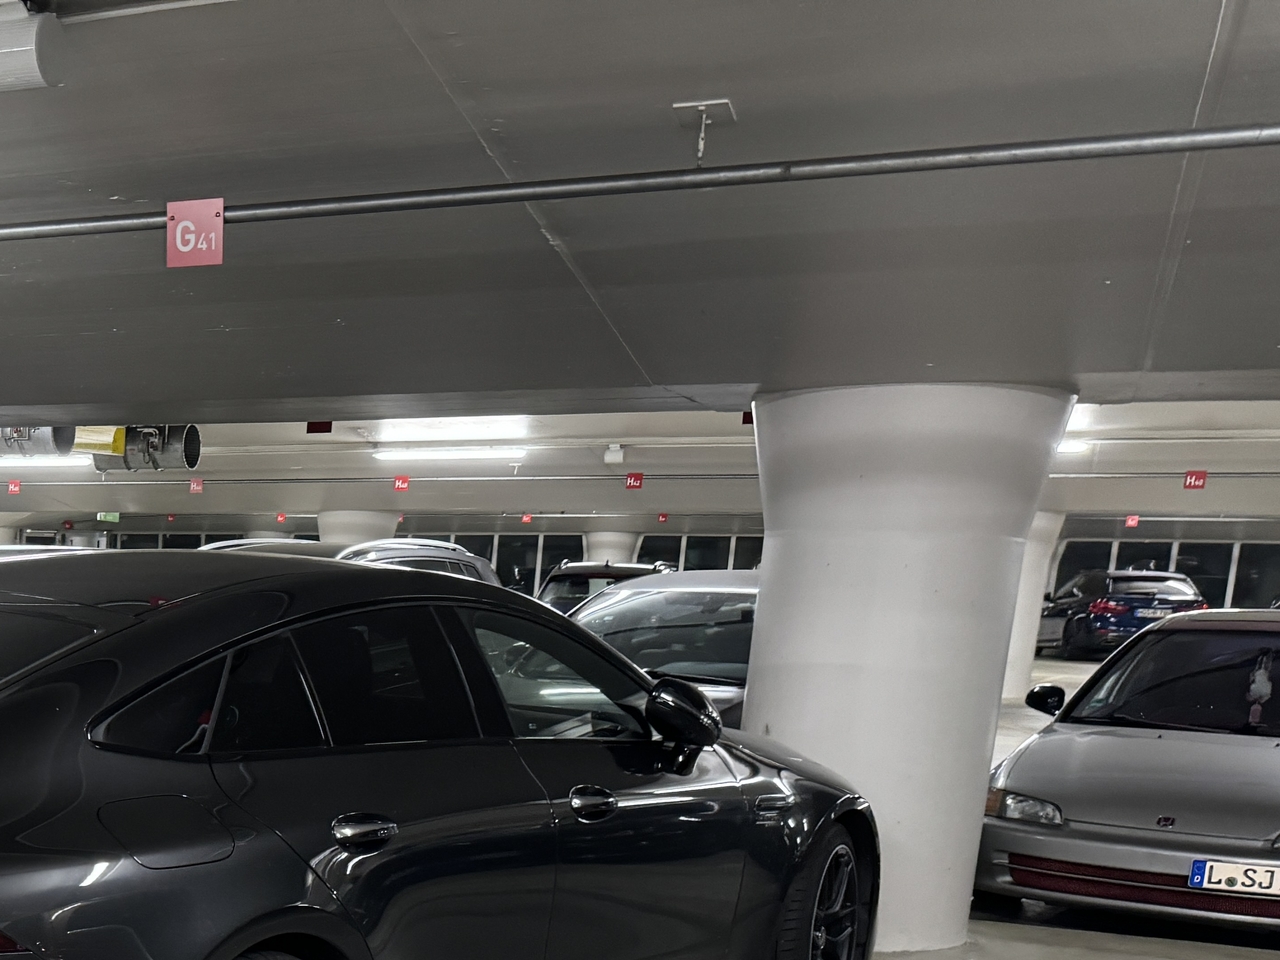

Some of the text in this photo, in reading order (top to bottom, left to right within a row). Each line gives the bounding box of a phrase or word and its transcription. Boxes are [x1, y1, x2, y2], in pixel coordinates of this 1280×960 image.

[176, 220, 216, 253] G41
[1207, 864, 1223, 885] L
[1240, 868, 1276, 890] SJ
